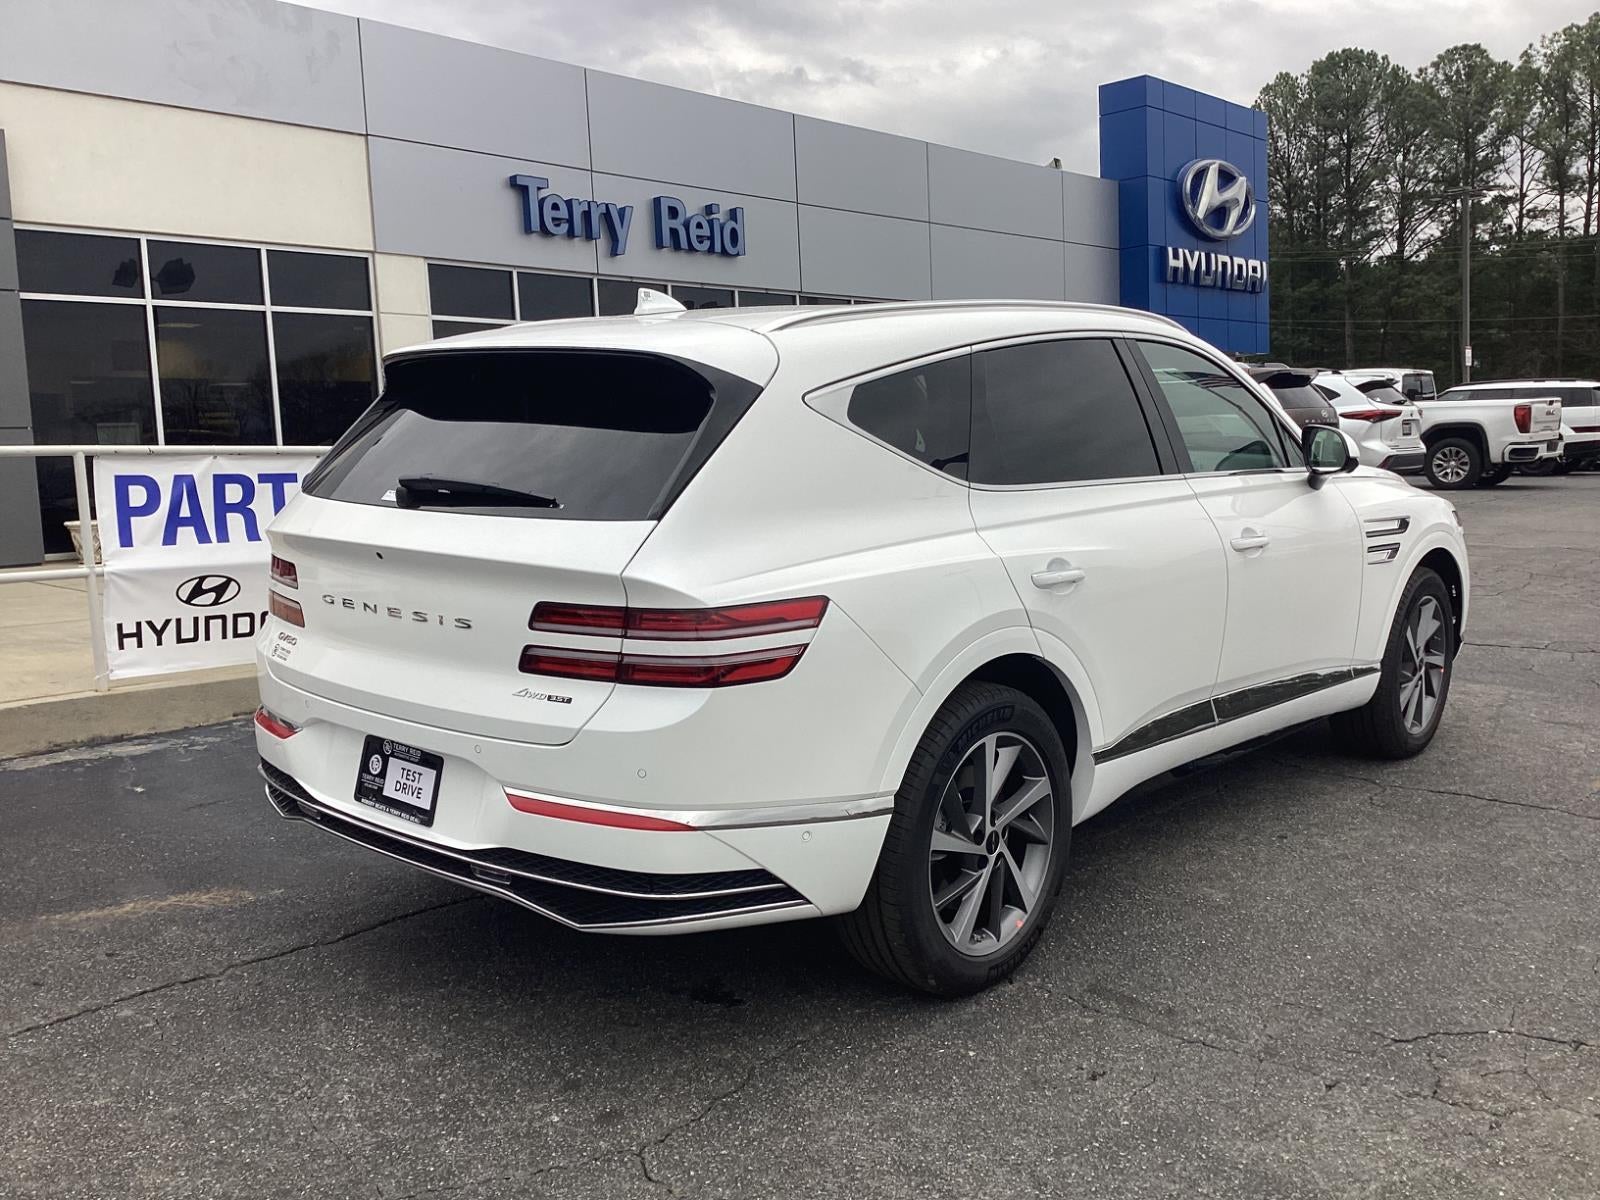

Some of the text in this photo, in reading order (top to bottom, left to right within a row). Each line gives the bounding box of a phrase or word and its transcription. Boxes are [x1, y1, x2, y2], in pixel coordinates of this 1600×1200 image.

[510, 174, 746, 257] Terry Reid
[1167, 246, 1268, 293] HYUNDAI
[322, 594, 473, 630] GENESIS
[393, 743, 409, 753] TERRY
[400, 767, 423, 784] TEST
[394, 780, 423, 799] DRIVE
